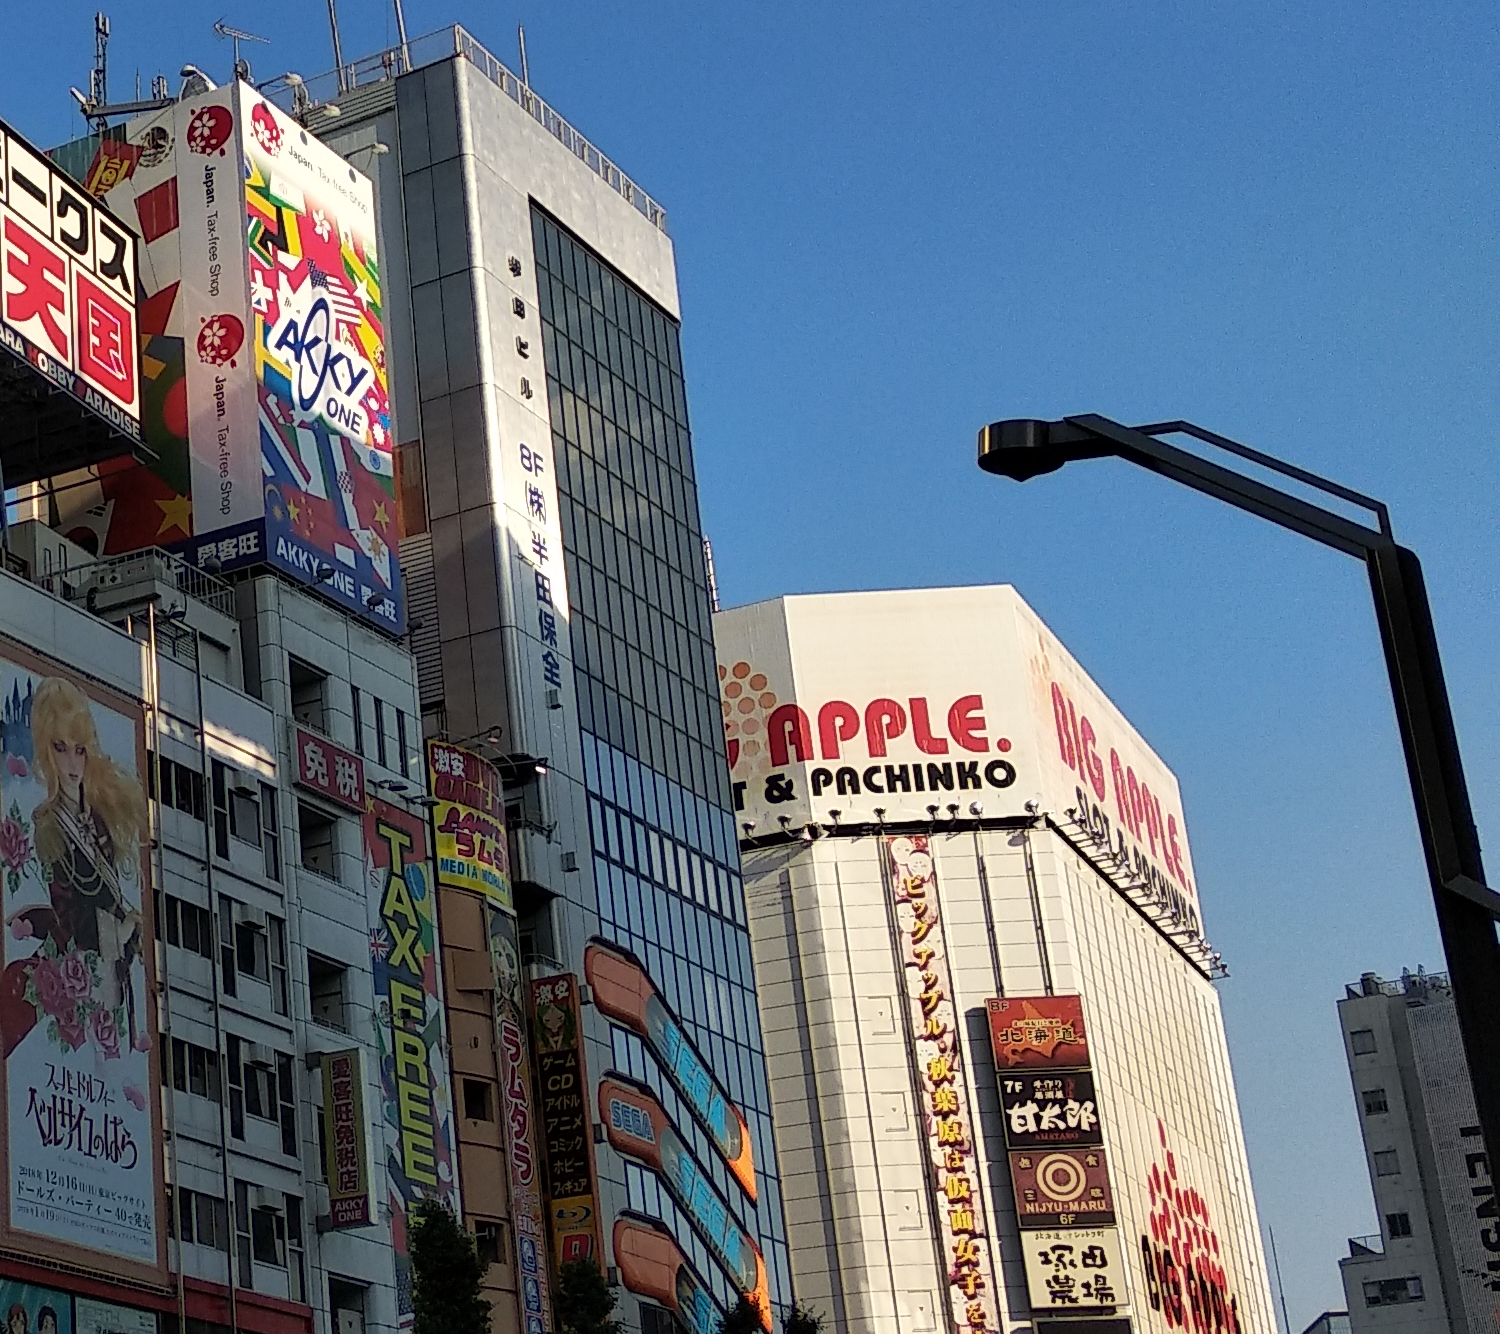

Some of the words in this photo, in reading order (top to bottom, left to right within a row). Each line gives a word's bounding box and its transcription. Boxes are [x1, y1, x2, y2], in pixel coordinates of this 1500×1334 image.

[205, 213, 220, 265] Tax-free
[207, 264, 221, 297] Shop
[5, 216, 135, 405] 天国
[28, 344, 75, 391] HOBBY
[75, 373, 142, 441] PARADISE
[326, 401, 363, 434] ONE
[216, 425, 230, 477] Tax-free
[519, 443, 545, 477] 8F
[219, 478, 232, 515] Shop
[277, 536, 319, 575] AKKY
[1051, 681, 1105, 803] BIG
[302, 737, 360, 805] 免税
[434, 748, 465, 780] 激安
[764, 774, 798, 804] &
[812, 760, 1016, 796] PACHINKO
[440, 857, 478, 880] MEDIA
[378, 824, 421, 976] TAX
[999, 1027, 1077, 1044] 北海道
[542, 1056, 576, 1072] ゲーム
[391, 980, 438, 1188] FREE
[547, 1074, 574, 1091] CD
[1004, 1080, 1023, 1094] 7F
[501, 1019, 534, 1186] ラムタラ
[545, 1092, 580, 1111] アイドル
[1007, 1100, 1097, 1134] 甘太郎
[26, 1087, 137, 1169] ベルサイユのばら
[547, 1116, 582, 1134] アニメ
[610, 1099, 655, 1143] SEGA
[550, 1135, 583, 1153] コミック
[553, 1158, 585, 1174] ホビー
[553, 1178, 588, 1195] フィギュア
[334, 1198, 366, 1213] AKKY
[338, 1210, 362, 1223] ONE
[1060, 1214, 1075, 1225] 6F
[1038, 1245, 1108, 1271] 塚田
[1046, 1274, 1115, 1304] 農場
